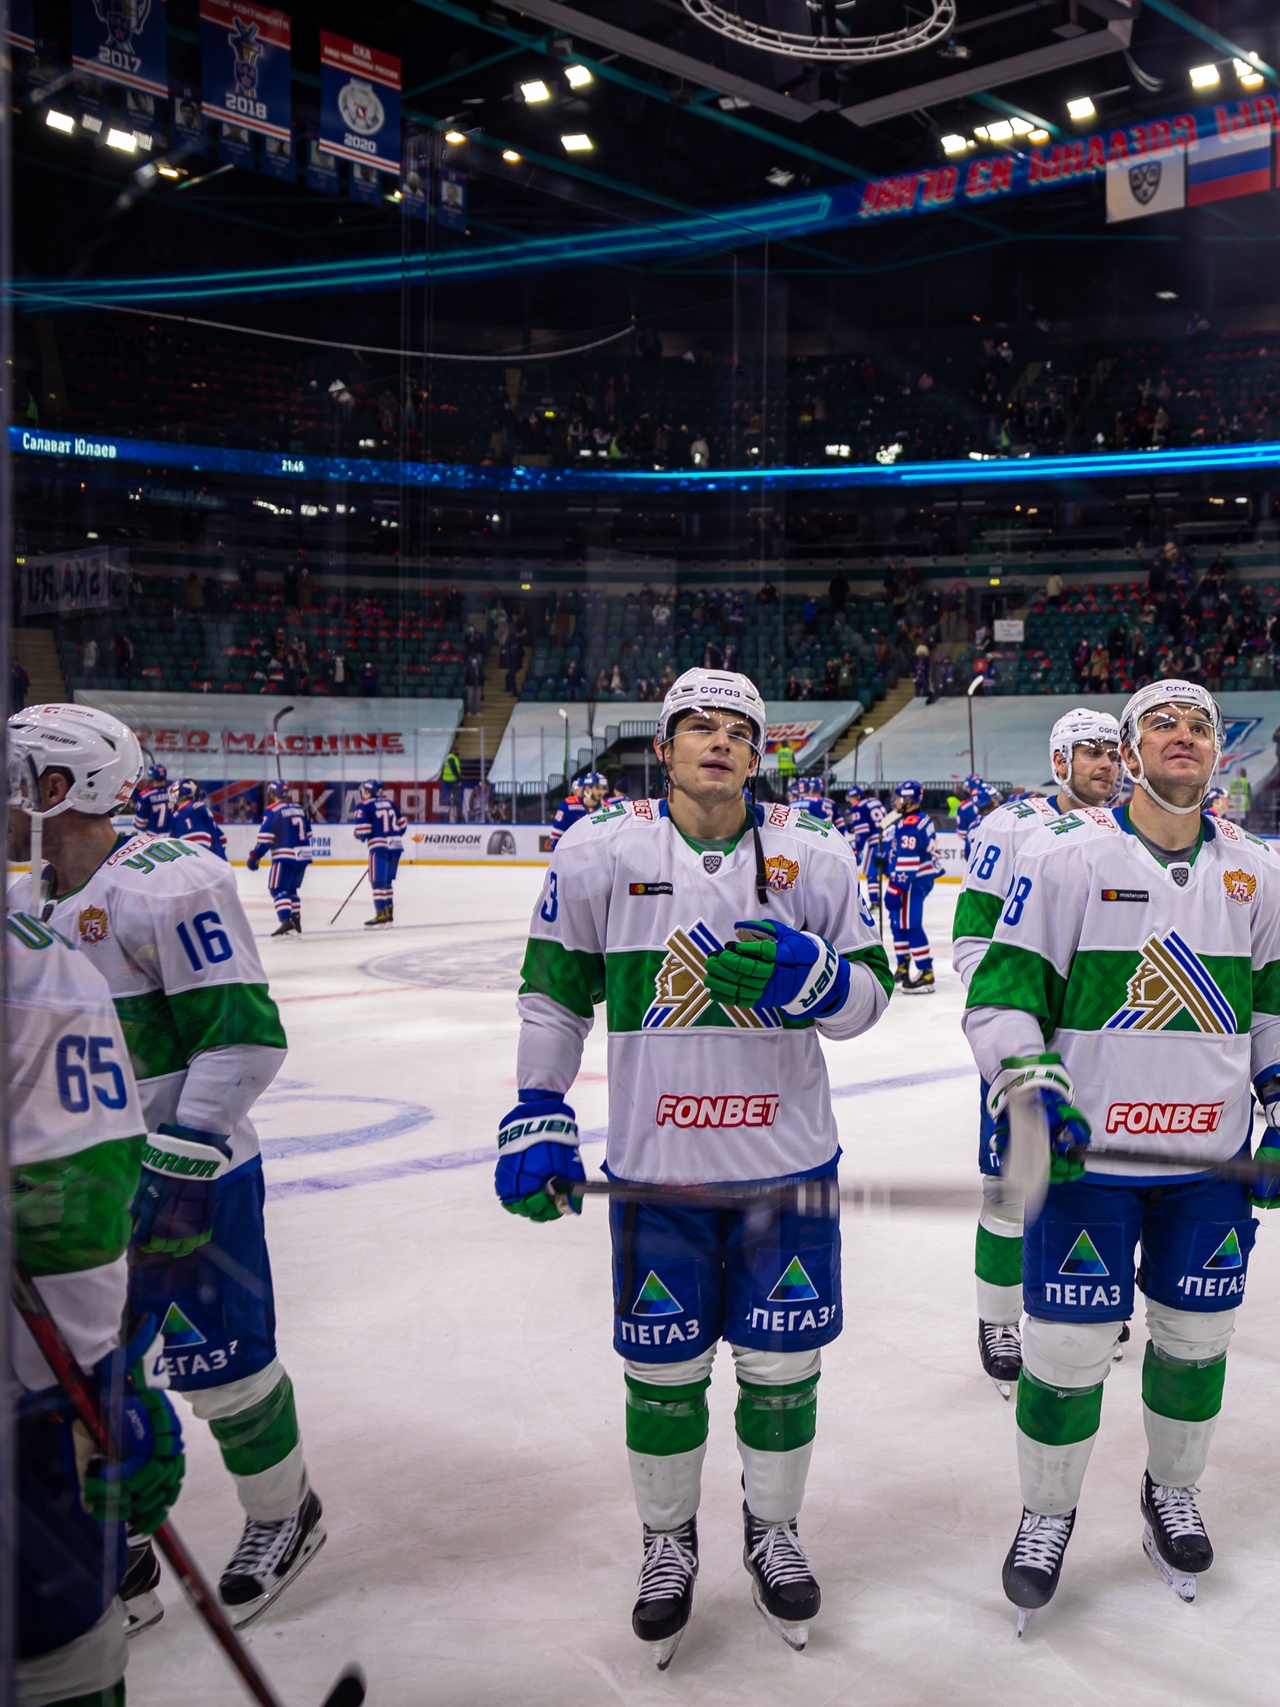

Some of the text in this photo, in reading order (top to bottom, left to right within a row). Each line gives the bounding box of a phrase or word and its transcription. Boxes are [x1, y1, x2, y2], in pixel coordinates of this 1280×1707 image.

[99, 45, 141, 73] 2017
[225, 92, 267, 120] 2018
[344, 132, 377, 153] 2020
[23, 432, 117, 459] Салават Юлаев
[699, 685, 741, 698] согаз
[222, 731, 404, 750] MACHINE
[1098, 726, 1118, 735] сога
[376, 809, 399, 833] 72
[901, 834, 916, 850] 39
[768, 866, 788, 884] 75
[1119, 891, 1148, 900] mastercard
[1231, 880, 1248, 895] 75
[176, 909, 234, 973] 16
[55, 1033, 128, 1114] 65
[656, 1093, 780, 1128] FONBET
[1105, 1101, 1225, 1134] FONBET
[1045, 1283, 1121, 1307] ПЕГАЗ
[1185, 1274, 1246, 1298] ПЕГАЗ
[622, 1318, 700, 1346] ПЕГАЗ
[752, 1307, 829, 1333] ПЕГАЗ
[163, 1347, 229, 1378] ЕГАЗ
